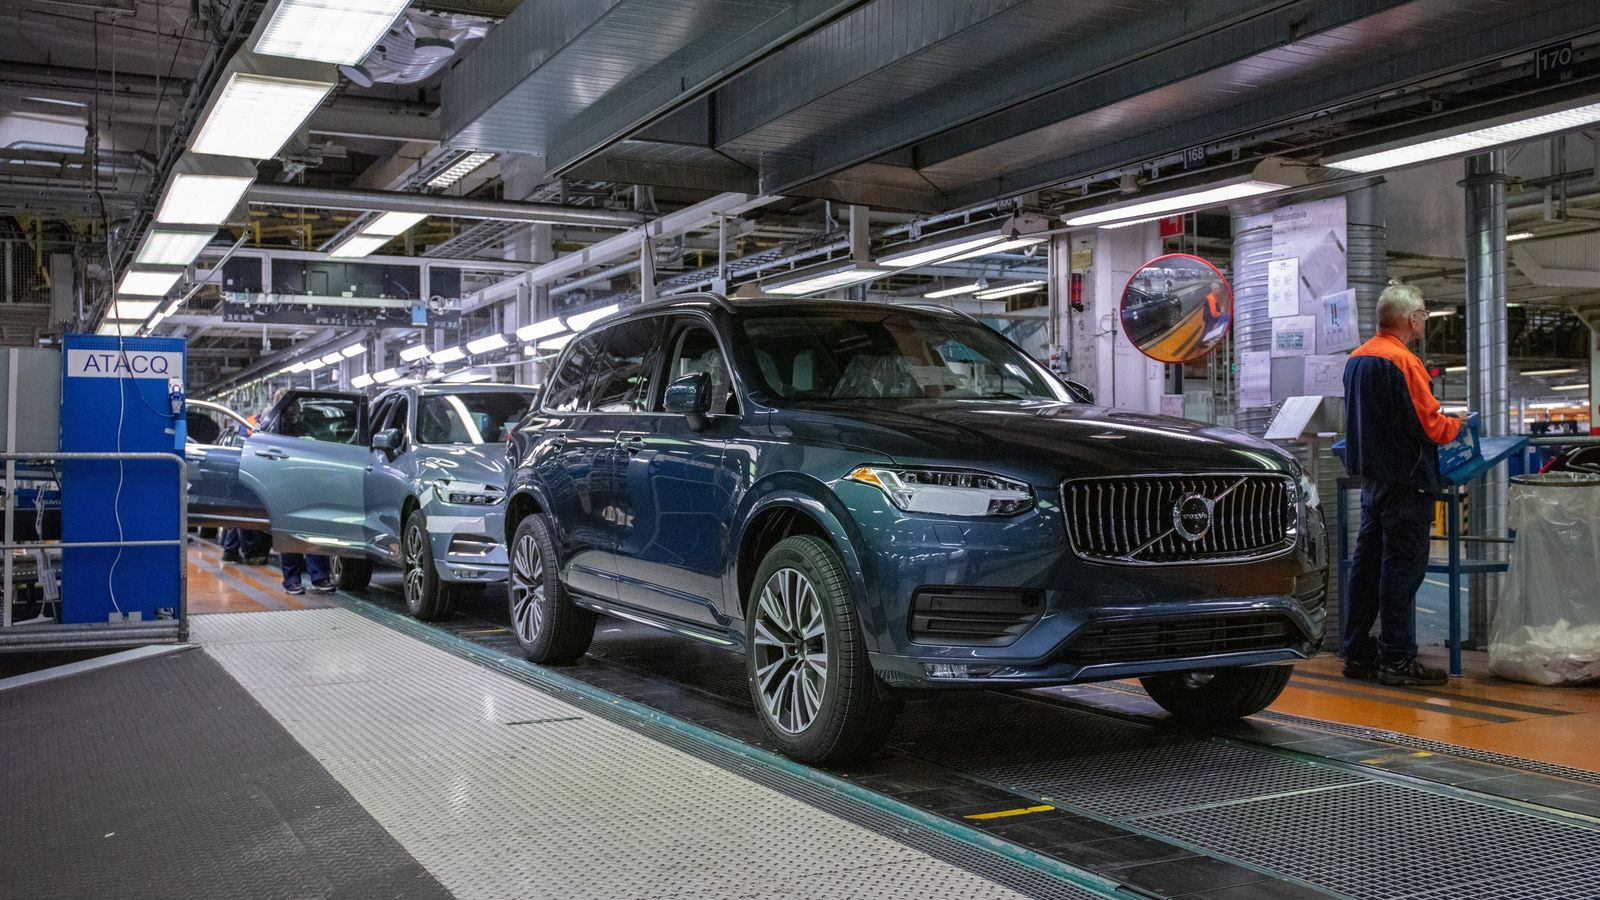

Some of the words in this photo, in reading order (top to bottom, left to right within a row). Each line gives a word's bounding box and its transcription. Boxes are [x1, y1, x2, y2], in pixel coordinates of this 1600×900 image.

[1541, 47, 1571, 70] 170
[1187, 147, 1204, 162] 168
[83, 354, 169, 375] ATACQ
[1182, 511, 1207, 519] VOLVO
